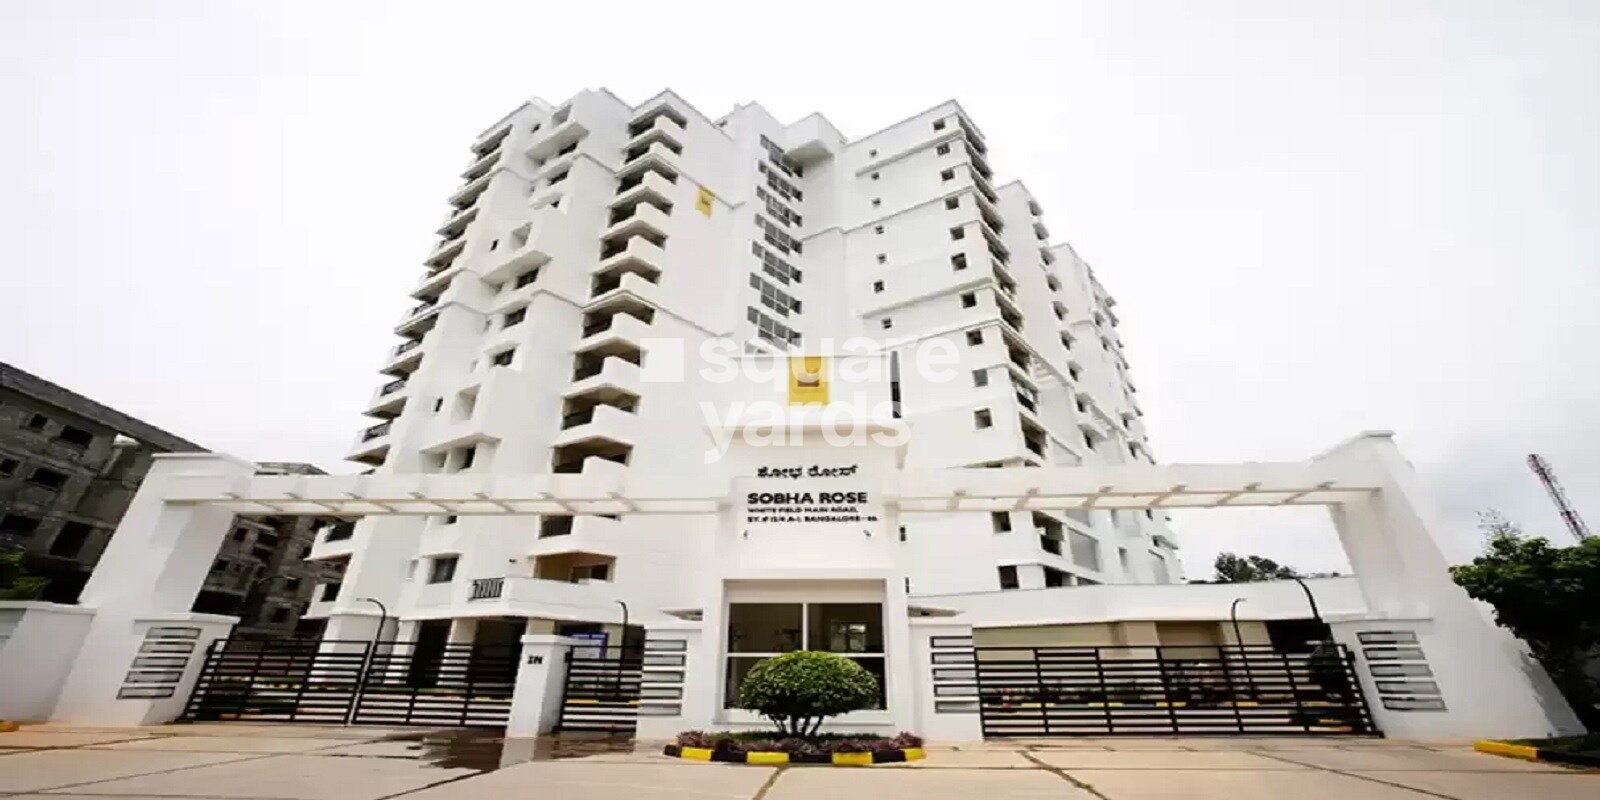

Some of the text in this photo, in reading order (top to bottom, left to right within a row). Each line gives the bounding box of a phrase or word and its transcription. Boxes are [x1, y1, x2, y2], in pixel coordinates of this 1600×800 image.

[747, 492, 868, 505] SOBHA ROSE
[527, 655, 543, 664] IN
